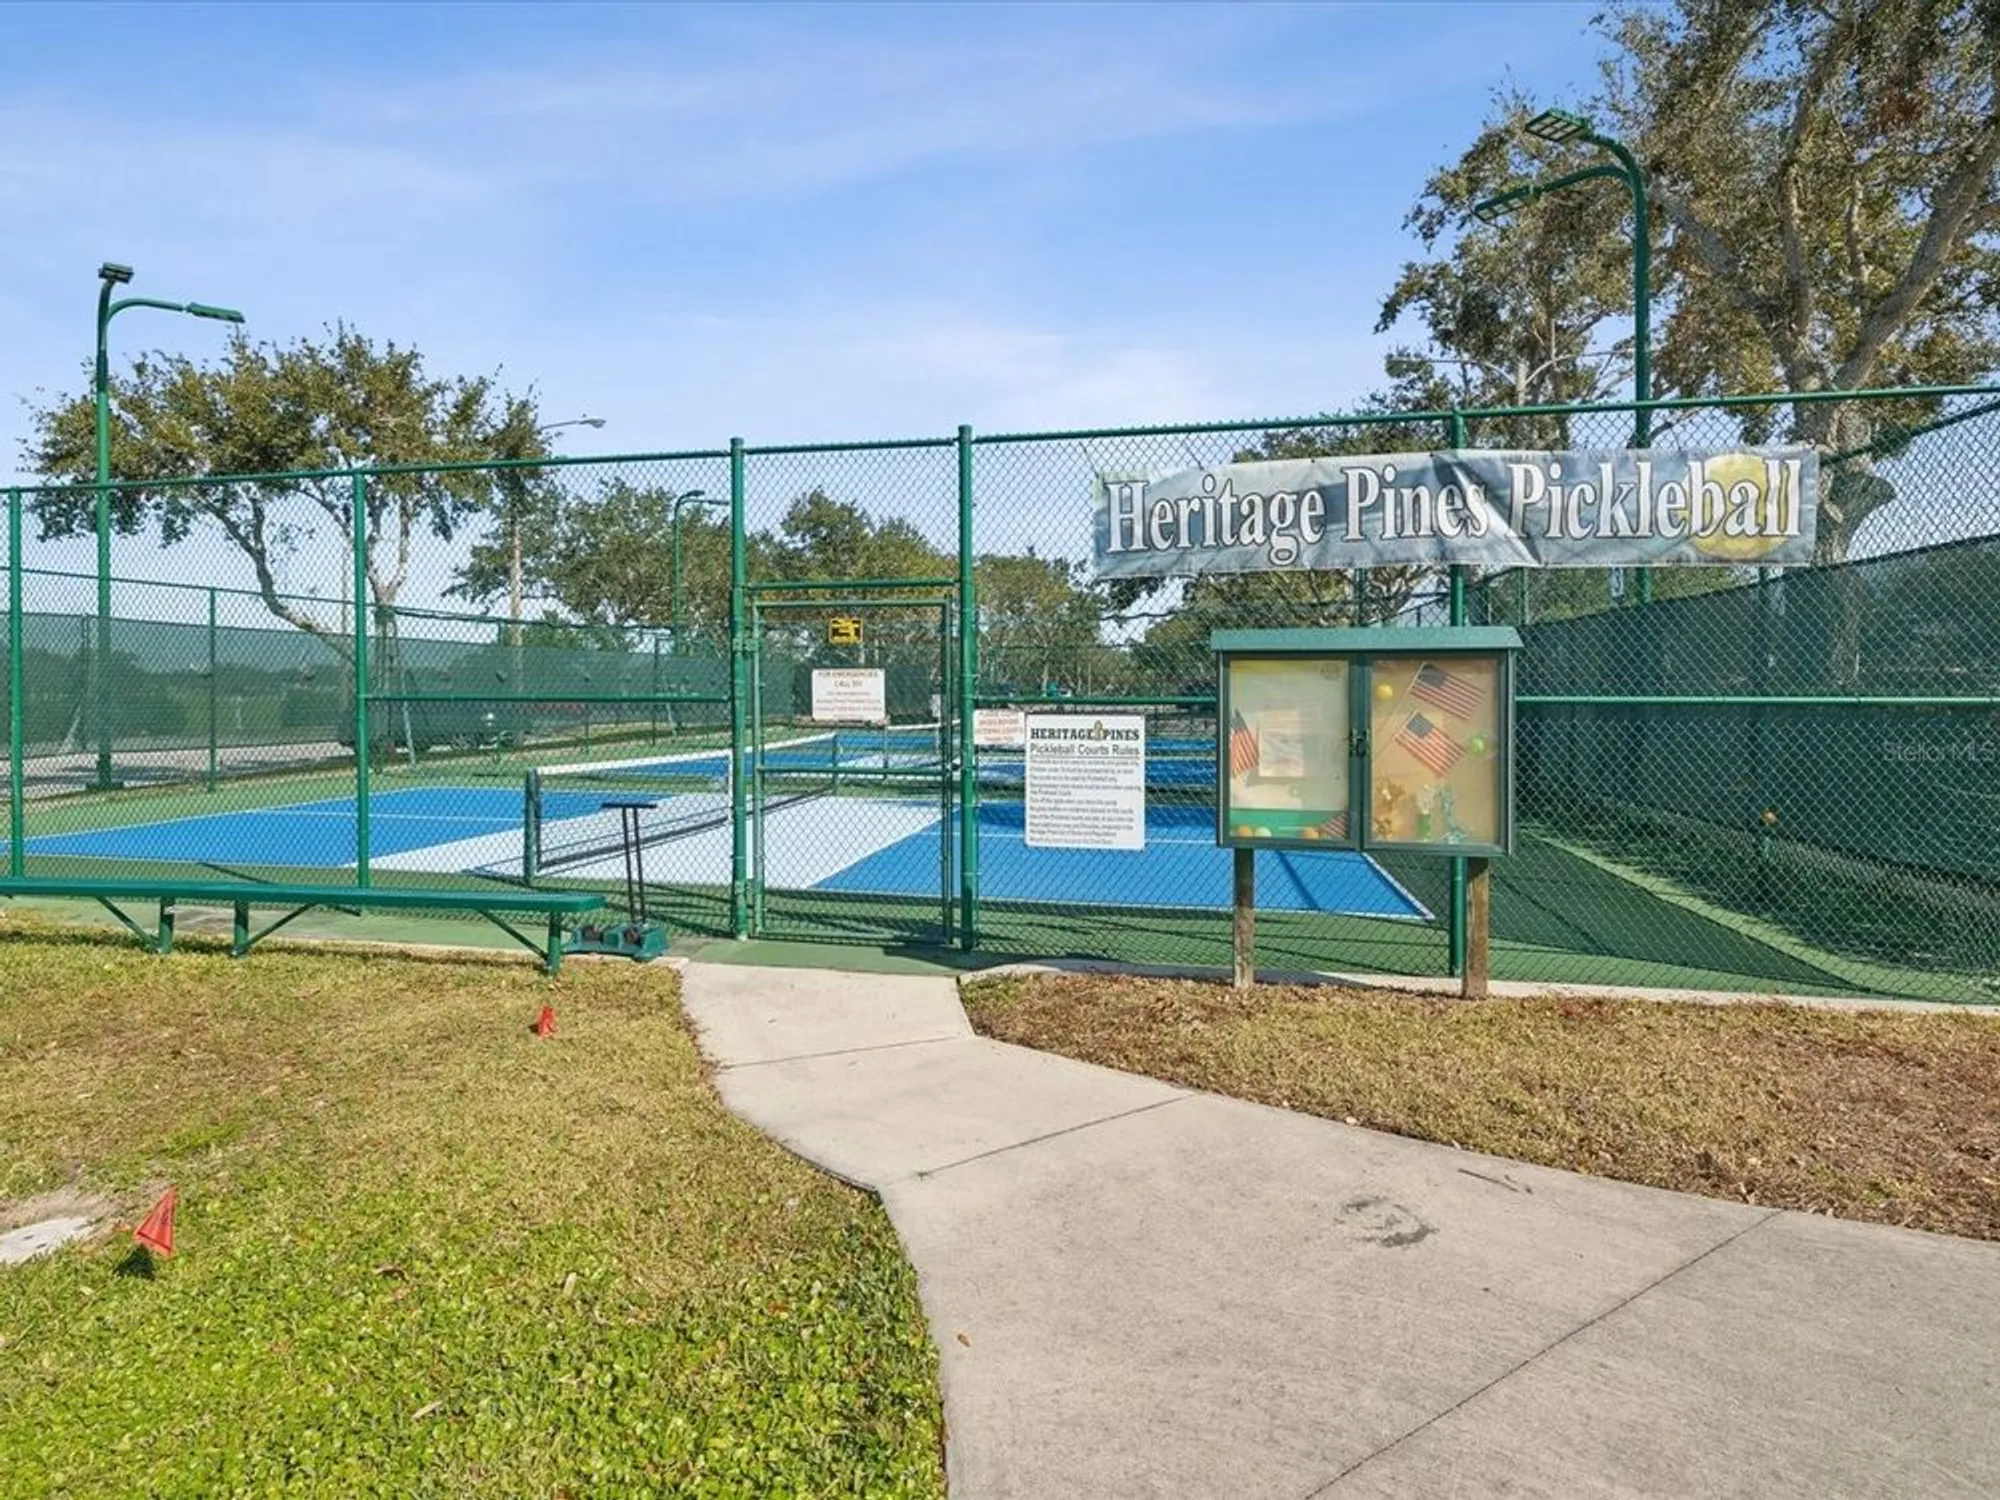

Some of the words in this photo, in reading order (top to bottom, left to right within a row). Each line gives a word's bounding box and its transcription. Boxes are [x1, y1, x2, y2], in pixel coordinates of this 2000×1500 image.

[1105, 475, 1326, 564] Heritage
[1340, 465, 1488, 542] Pines
[1507, 458, 1802, 542] Pickleball
[1030, 728, 1093, 740] HERITAGE
[1103, 728, 1140, 740] PINES
[1030, 743, 1075, 755] Pickleball
[1078, 744, 1109, 755] Courts
[1112, 744, 1140, 755] Rules
